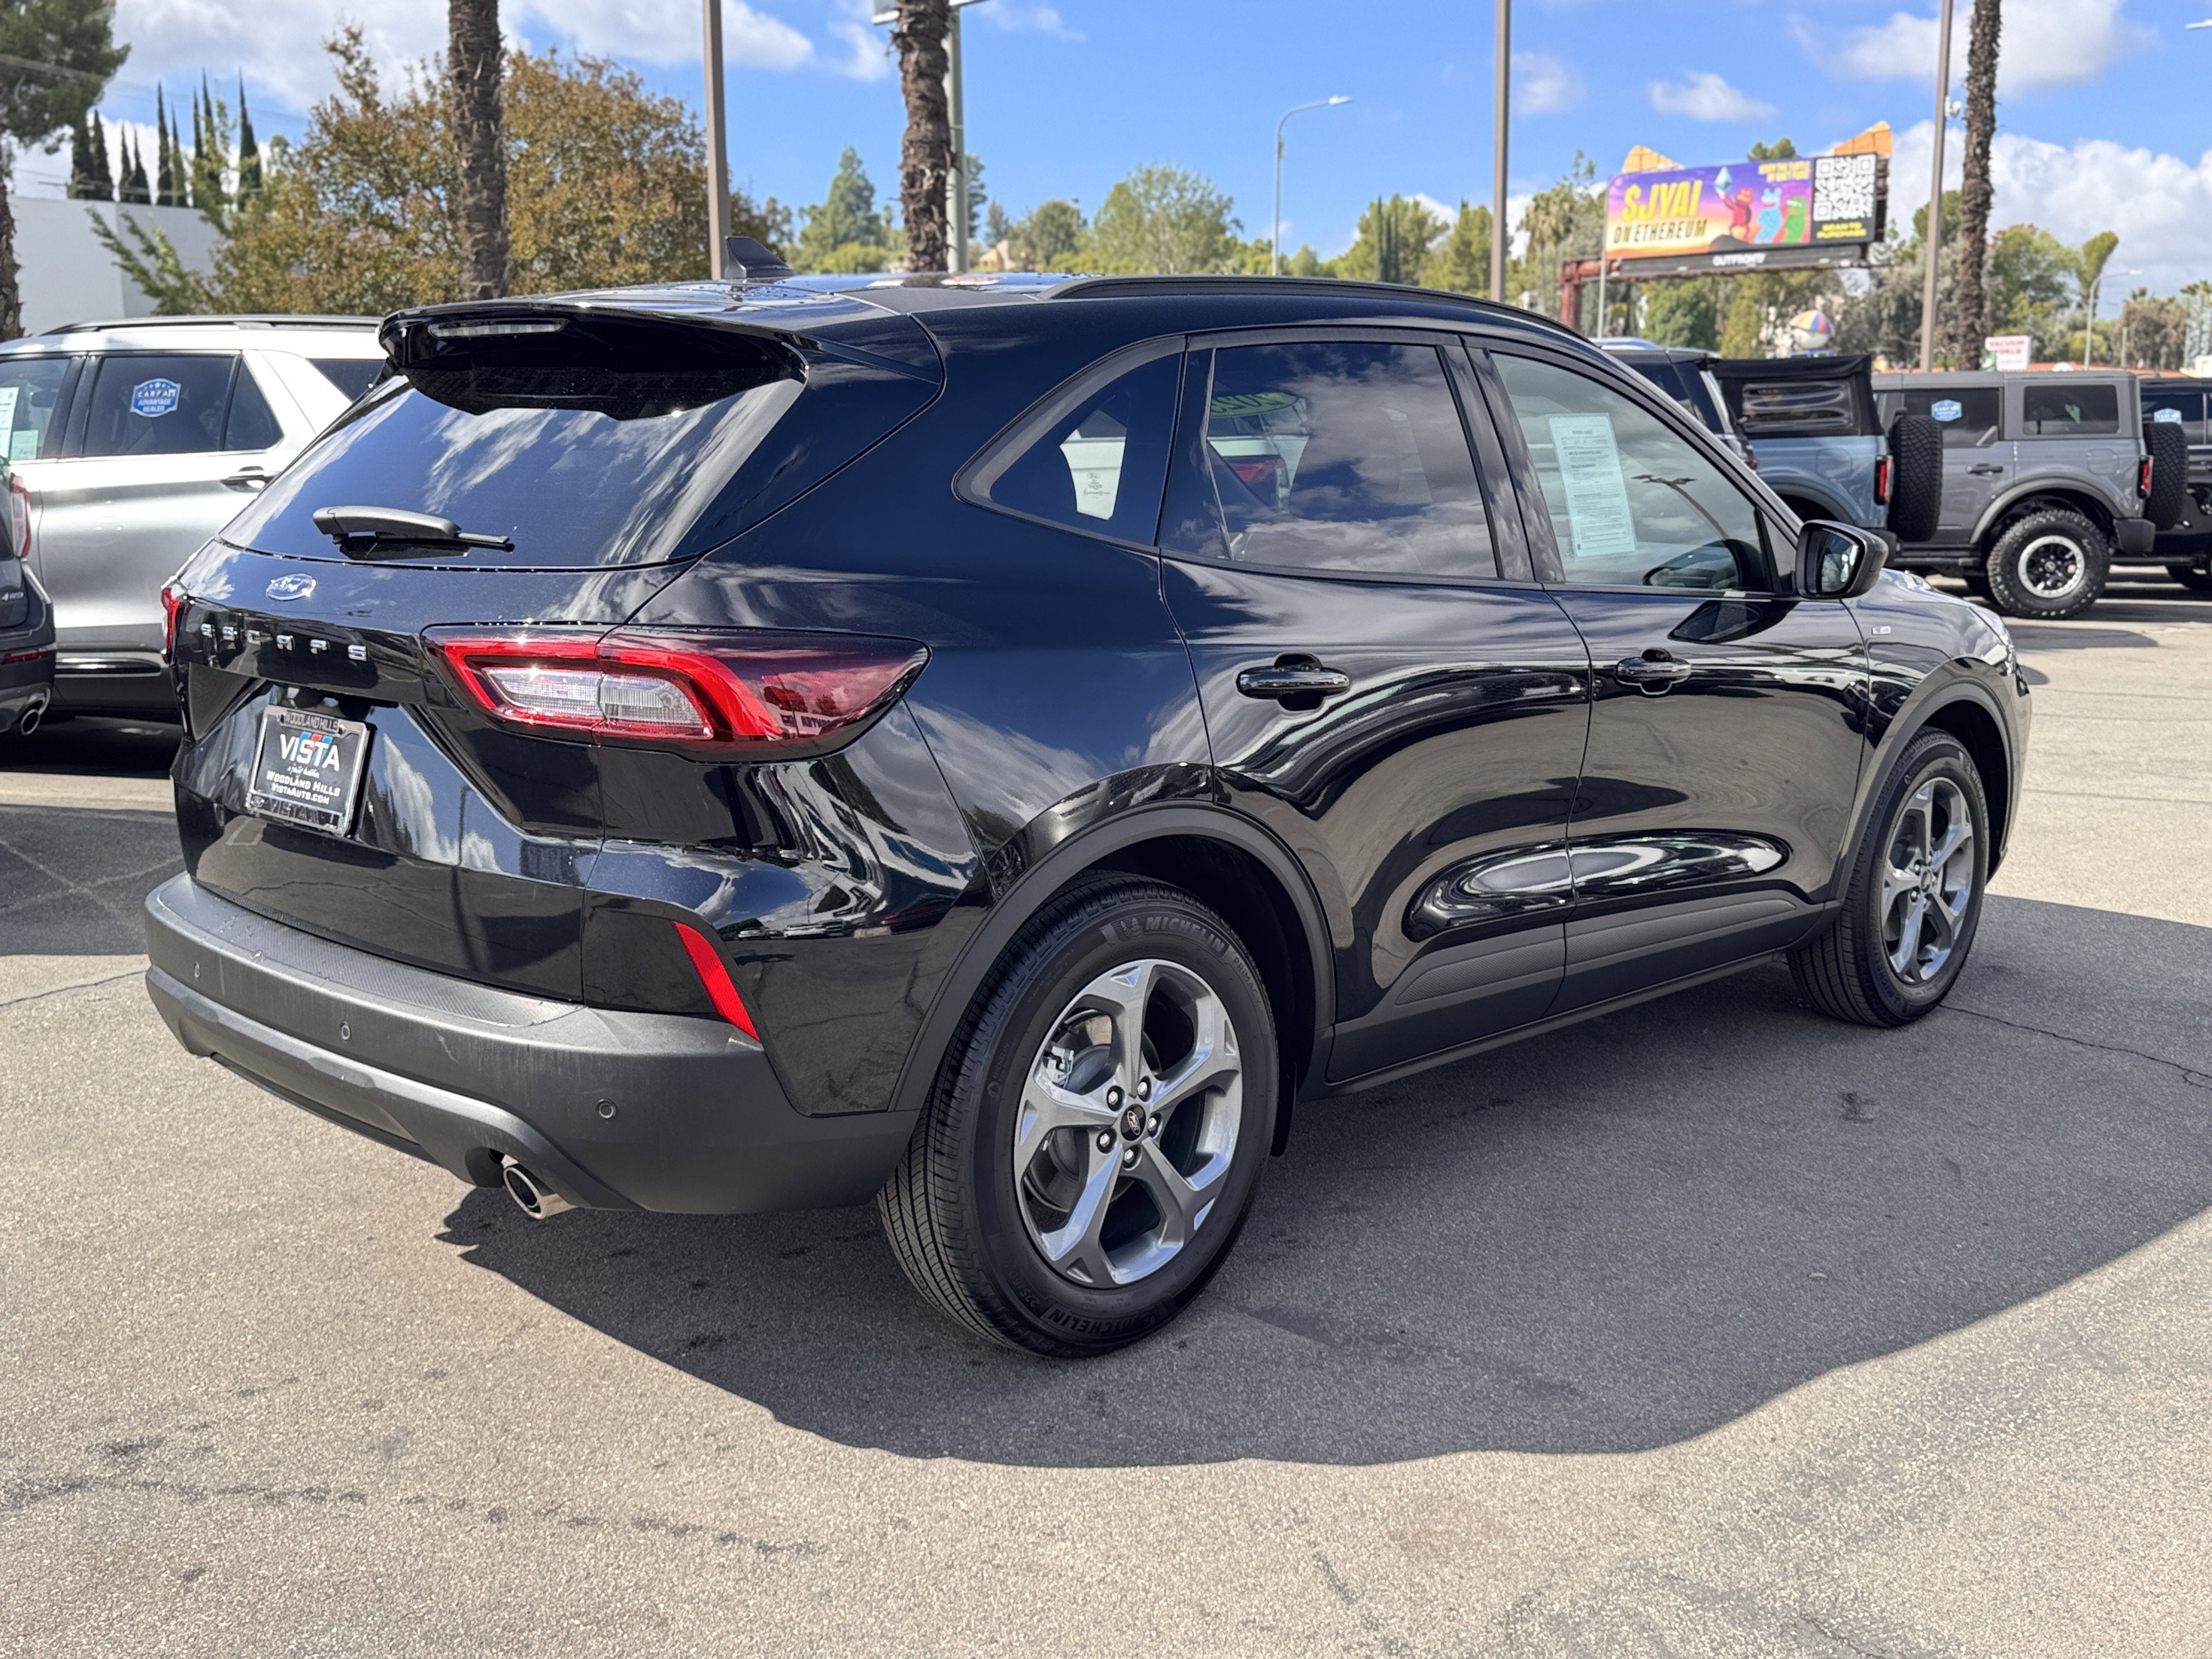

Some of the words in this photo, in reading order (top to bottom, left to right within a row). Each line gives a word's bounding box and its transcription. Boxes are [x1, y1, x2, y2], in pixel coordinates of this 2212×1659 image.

[1614, 225, 1631, 244] ON
[1634, 219, 1707, 242] ETHEREUM
[280, 733, 340, 771] VISTA
[266, 770, 311, 789] WOODLAND
[313, 781, 341, 797] HILLS
[1146, 916, 1226, 953] MICHELIN
[1233, 956, 1262, 1004] PRIMACY
[1048, 1308, 1135, 1335] MICHELIN
